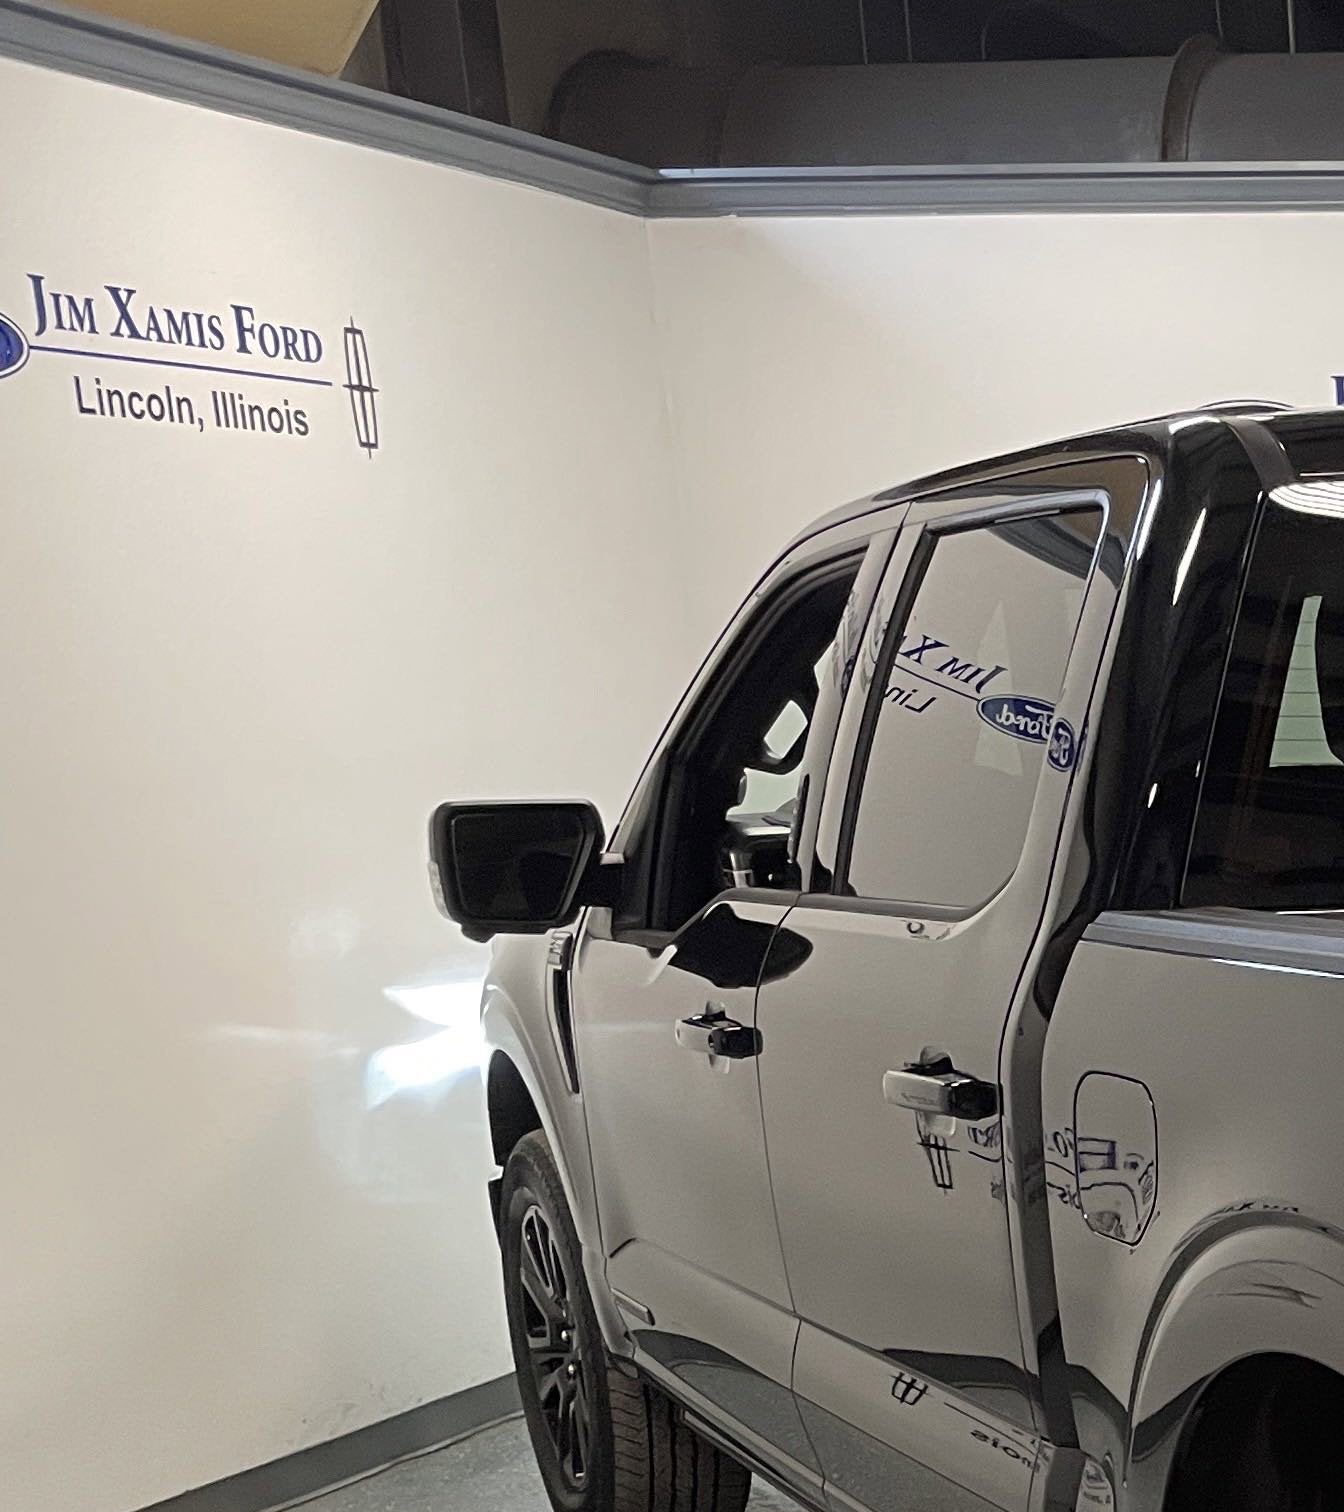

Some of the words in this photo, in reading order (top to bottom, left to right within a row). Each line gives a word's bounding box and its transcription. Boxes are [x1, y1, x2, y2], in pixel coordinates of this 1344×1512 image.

[26, 273, 99, 337] JIM
[104, 285, 225, 351] XAMIS
[230, 304, 323, 363] FORD
[73, 375, 204, 432] Lincoln,
[211, 390, 310, 436] Illinois
